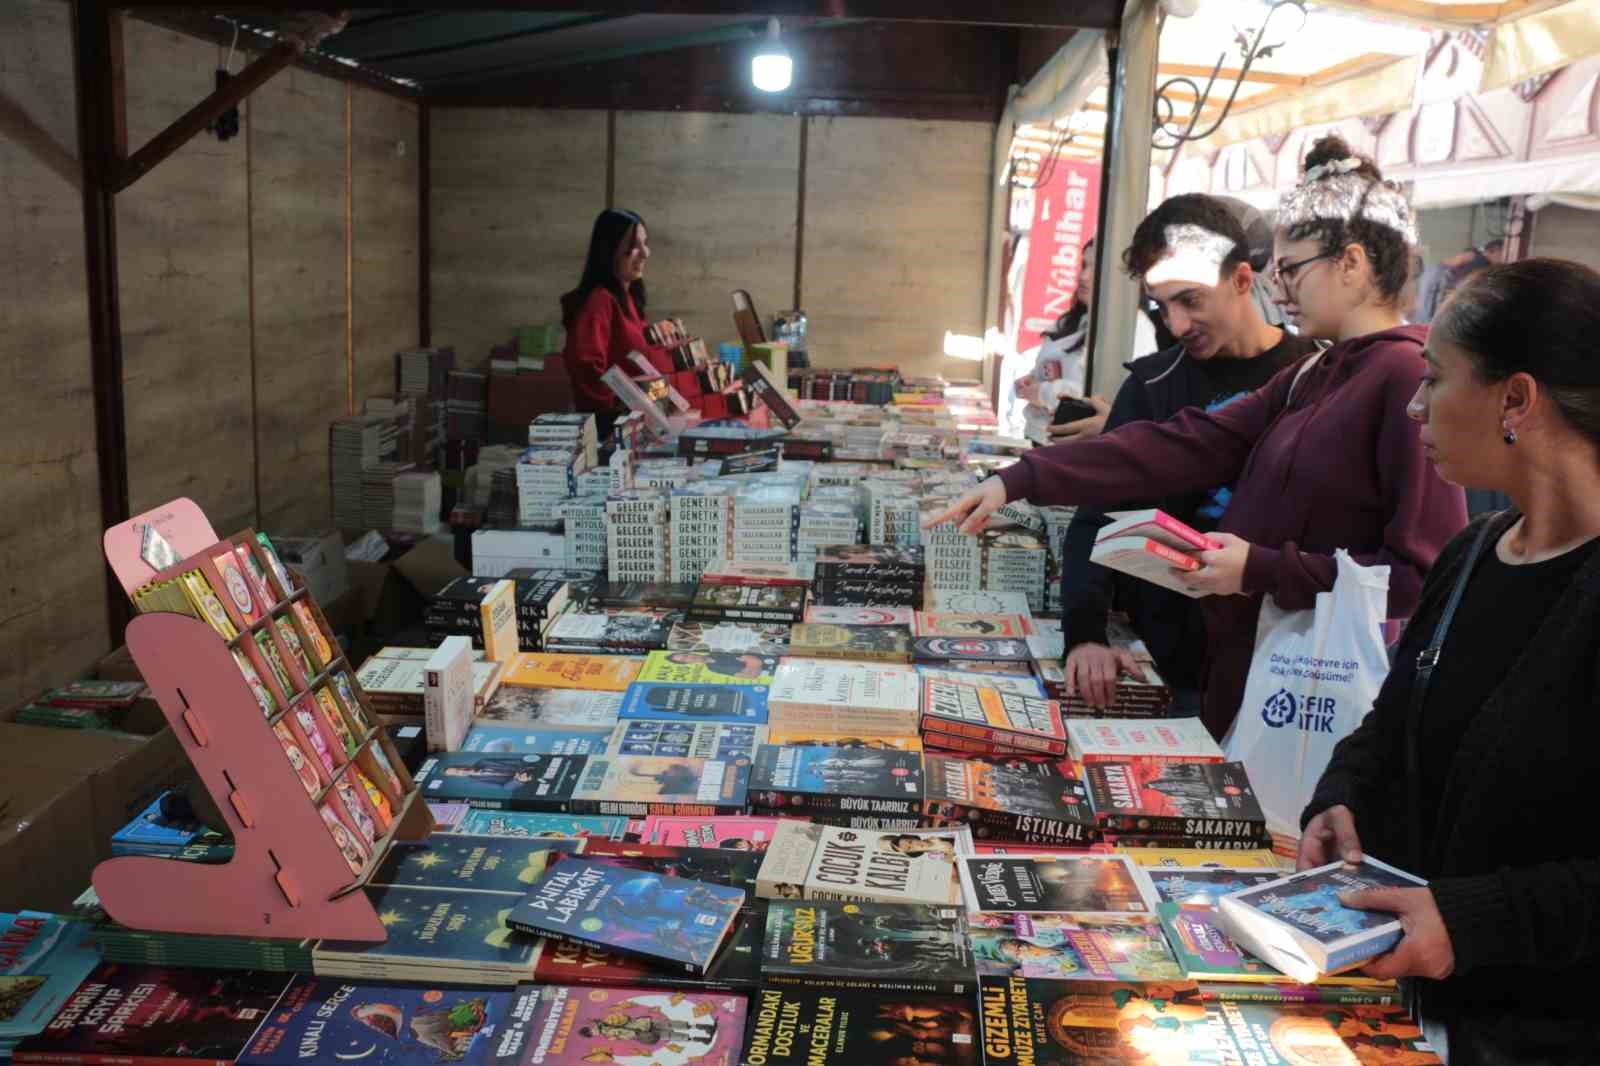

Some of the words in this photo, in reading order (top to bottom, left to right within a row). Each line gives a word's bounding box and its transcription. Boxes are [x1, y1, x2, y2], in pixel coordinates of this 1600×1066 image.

[840, 796, 869, 810] BÜYÜK
[871, 800, 909, 813] TAARRUZ
[1185, 819, 1251, 837] SAKARYA
[78, 988, 123, 1027] KAYIP
[298, 1019, 326, 1058] KINALI
[772, 1001, 801, 1057] DOSTLUK
[807, 996, 837, 1066] MACERALAR
